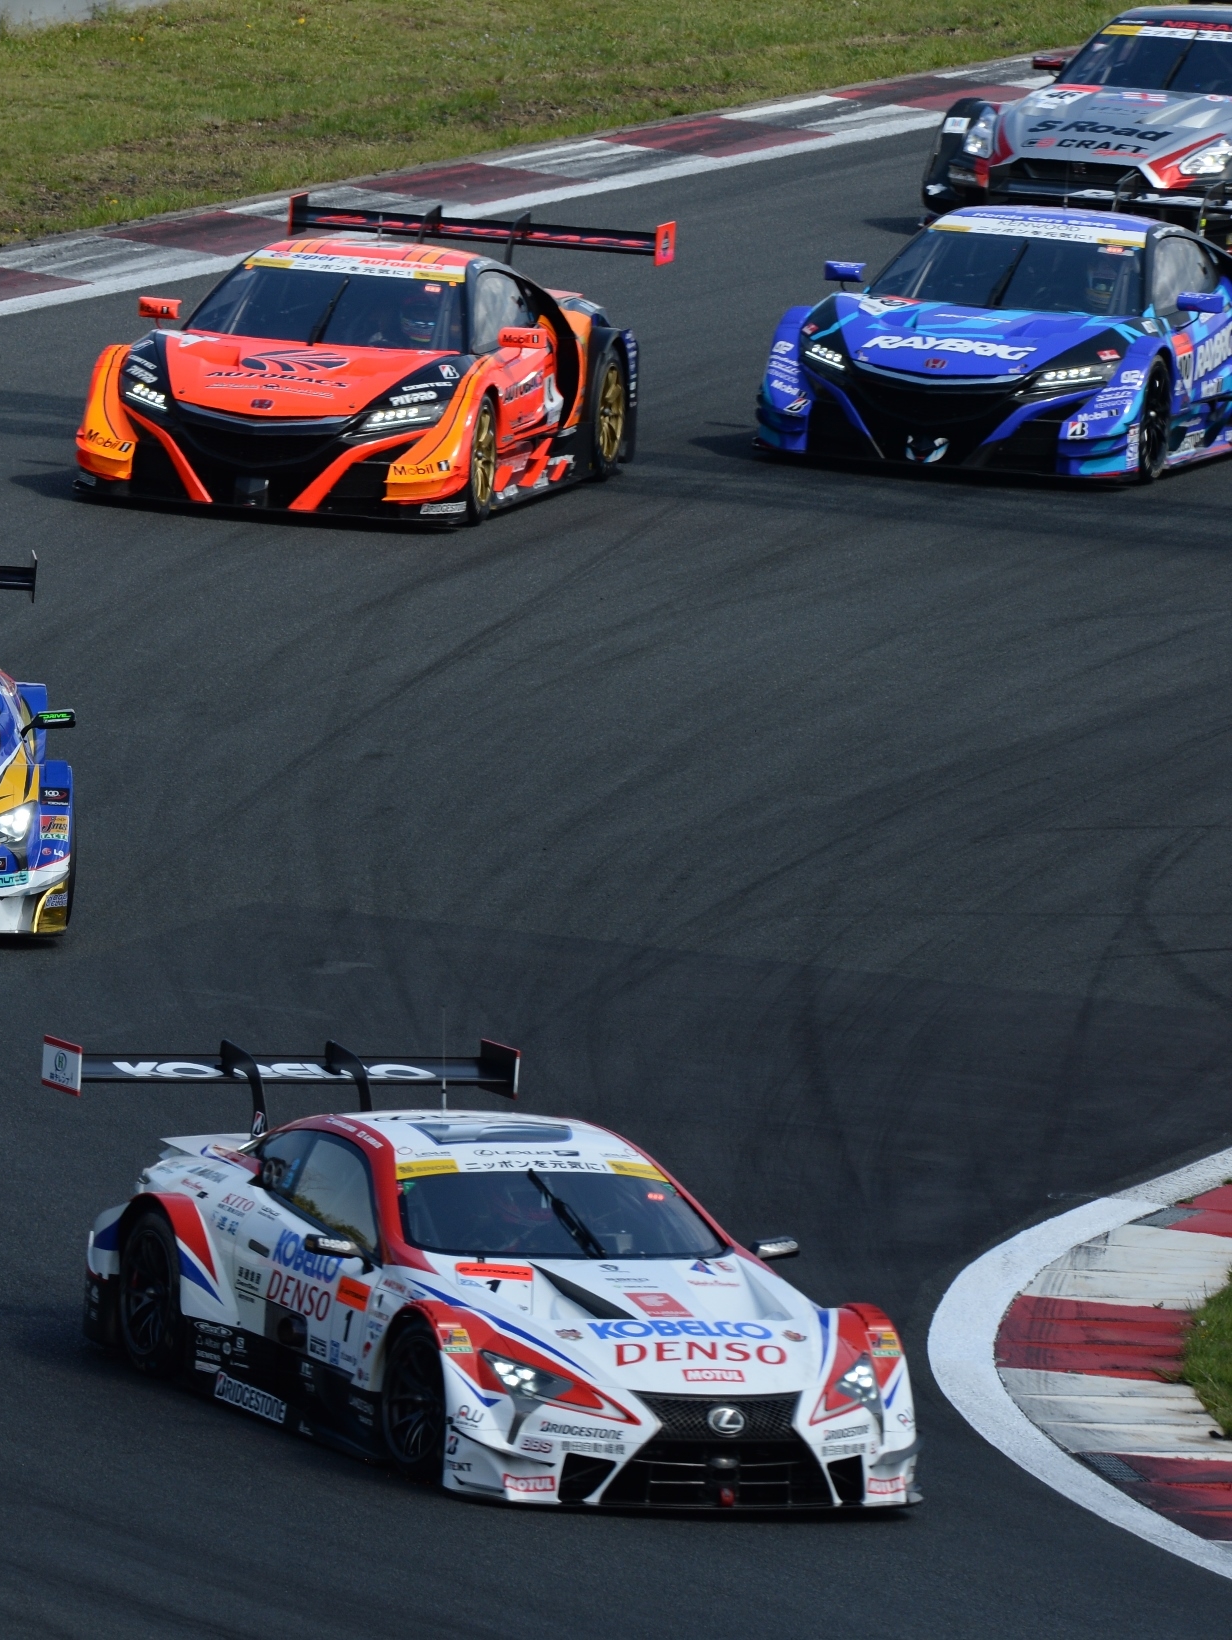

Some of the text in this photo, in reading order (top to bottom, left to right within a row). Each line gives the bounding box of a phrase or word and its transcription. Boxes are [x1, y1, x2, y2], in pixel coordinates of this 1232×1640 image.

[1162, 20, 1232, 31] NISSA
[1060, 120, 1174, 142] Road
[1056, 138, 1148, 154] CRAFT
[972, 212, 1023, 221] Honda
[997, 220, 1081, 232] KENWOOD
[358, 258, 444, 271] AUTOBACS
[502, 334, 531, 344] Mobil
[862, 335, 1039, 361] RAYBRIG
[205, 370, 354, 390] AUTOBACS
[1078, 409, 1109, 422] Mobil
[86, 429, 119, 449] Mobil
[393, 464, 435, 476] Mobil
[465, 1159, 608, 1173] ニッポンを元気に!
[221, 1192, 255, 1213] KITO
[468, 1267, 530, 1277] AUTOBACS
[485, 1278, 503, 1294] 1
[266, 1269, 332, 1322] DENSO
[342, 1308, 355, 1343] 1
[586, 1320, 774, 1340] KOBELCO
[614, 1341, 788, 1367] DENSO
[685, 1370, 743, 1382] MOTUL
[215, 1373, 287, 1422] BRIDGESTONE
[540, 1420, 625, 1441] BRIDGESTONE
[822, 1423, 871, 1441] BRIDGESTONE
[520, 1438, 554, 1454] BBS
[504, 1477, 554, 1492] MOTUL
